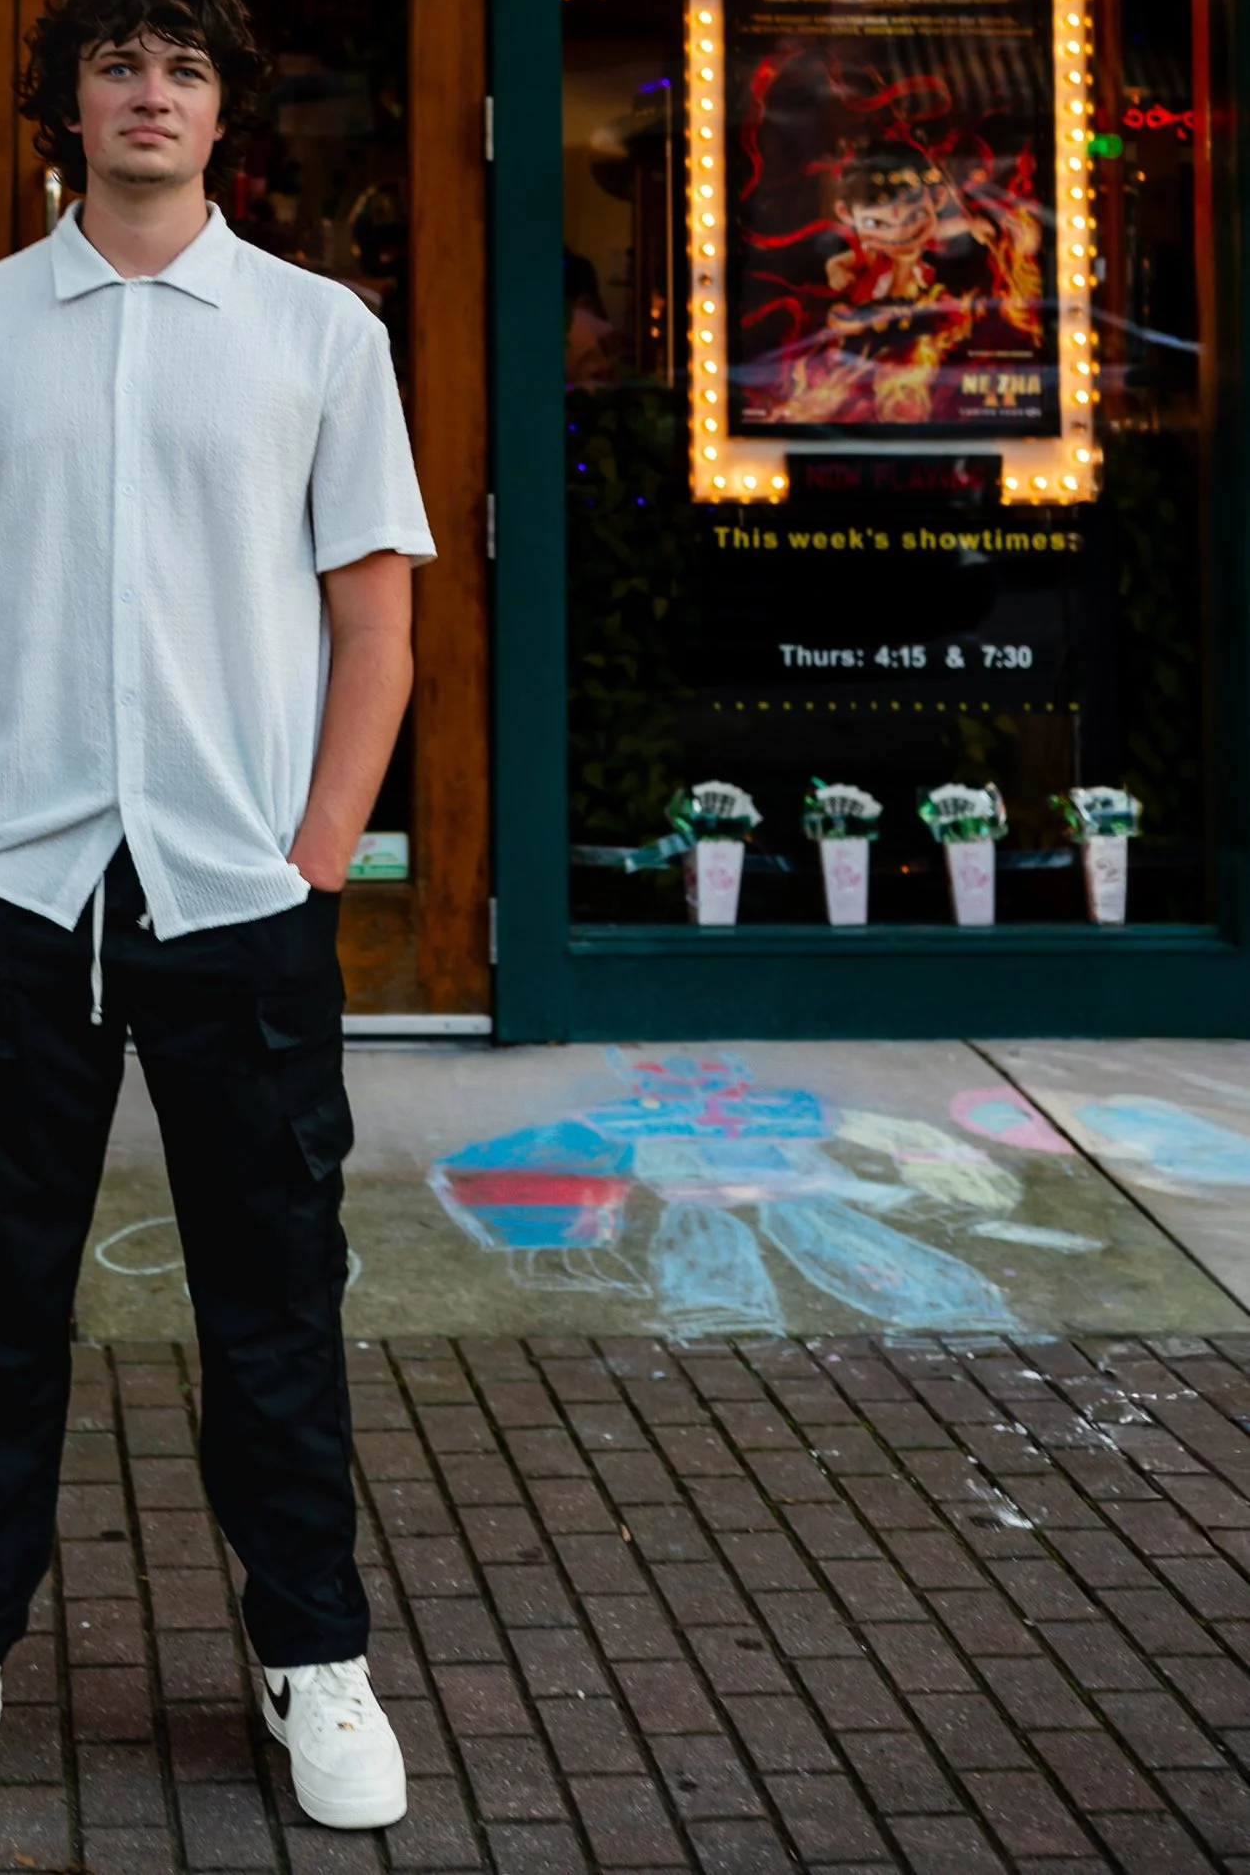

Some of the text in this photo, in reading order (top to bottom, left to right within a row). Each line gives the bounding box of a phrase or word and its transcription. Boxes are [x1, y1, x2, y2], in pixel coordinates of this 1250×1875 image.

[713, 526, 1081, 552] This week's showtimes:
[778, 643, 1033, 669] Thurs: 4:15 & 7:30
